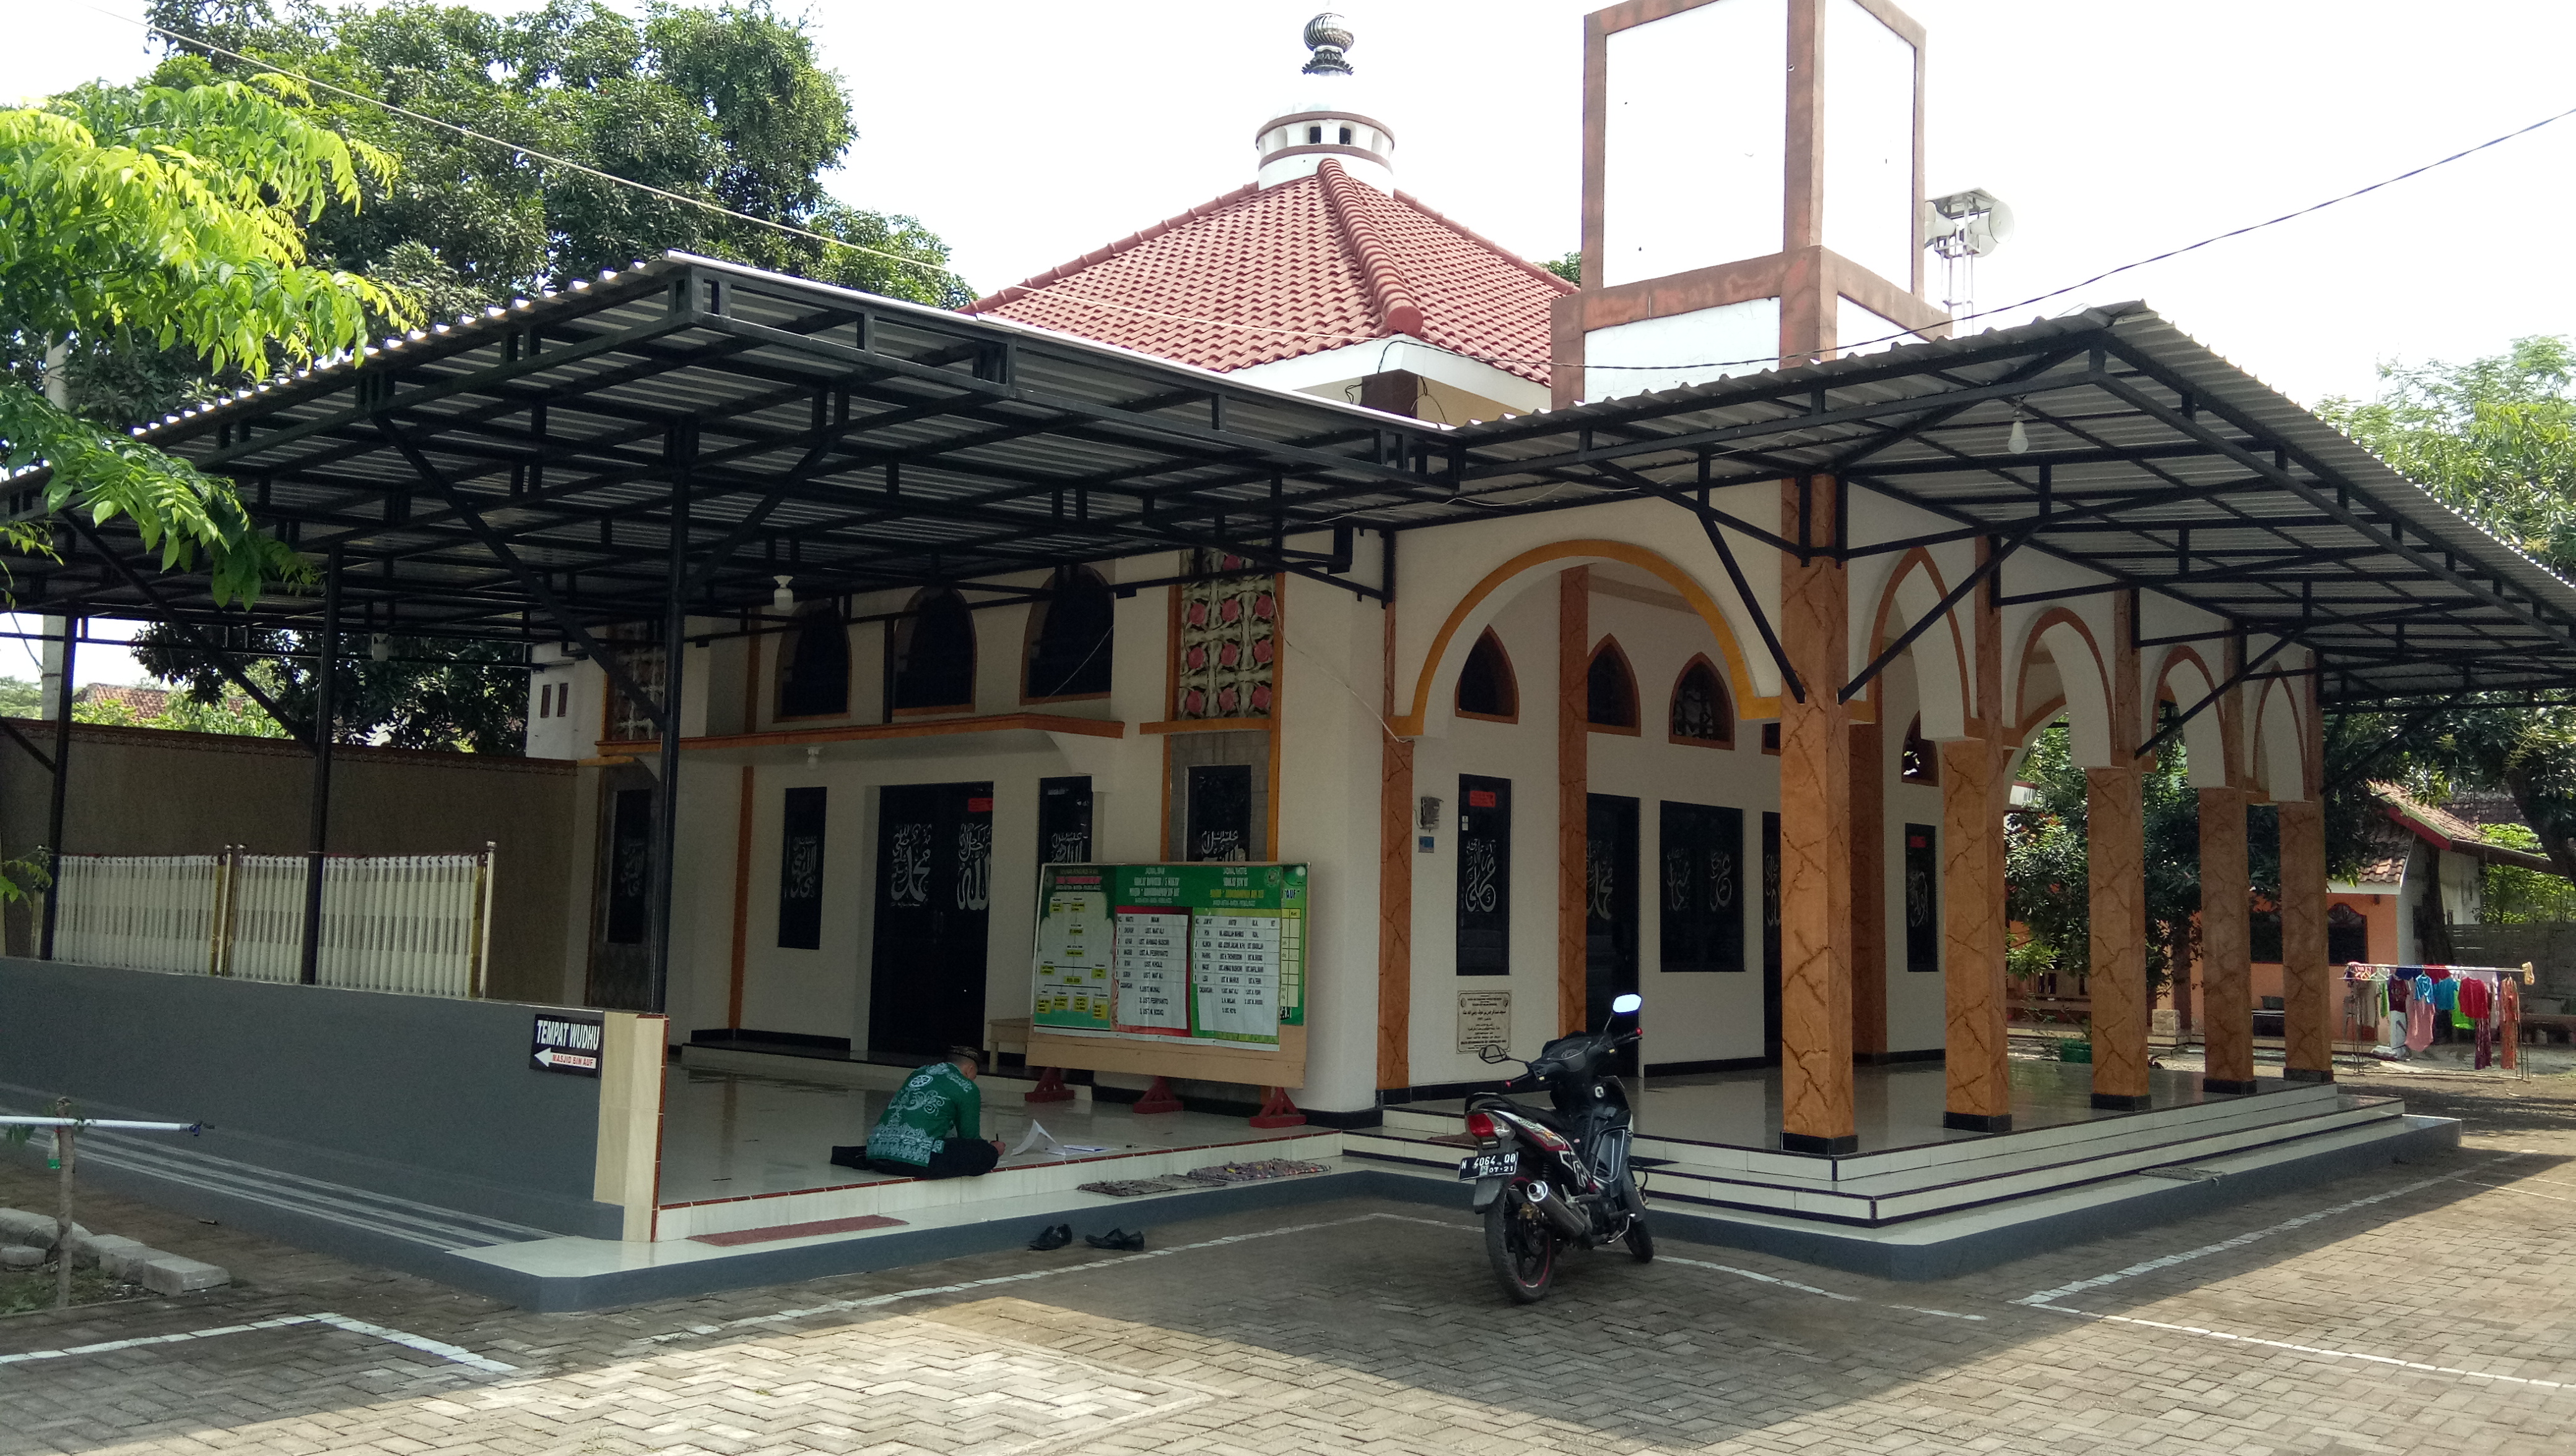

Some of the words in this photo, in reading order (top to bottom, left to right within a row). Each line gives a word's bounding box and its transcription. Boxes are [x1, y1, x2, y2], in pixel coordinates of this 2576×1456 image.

[537, 1020, 570, 1047] TEMPAT
[569, 1023, 600, 1051] WUDHU
[552, 1054, 572, 1065] MASJID
[572, 1056, 582, 1065] BIN
[583, 1057, 593, 1066] AUF
[1461, 1159, 1467, 1169] N
[1474, 1155, 1496, 1168] 4064
